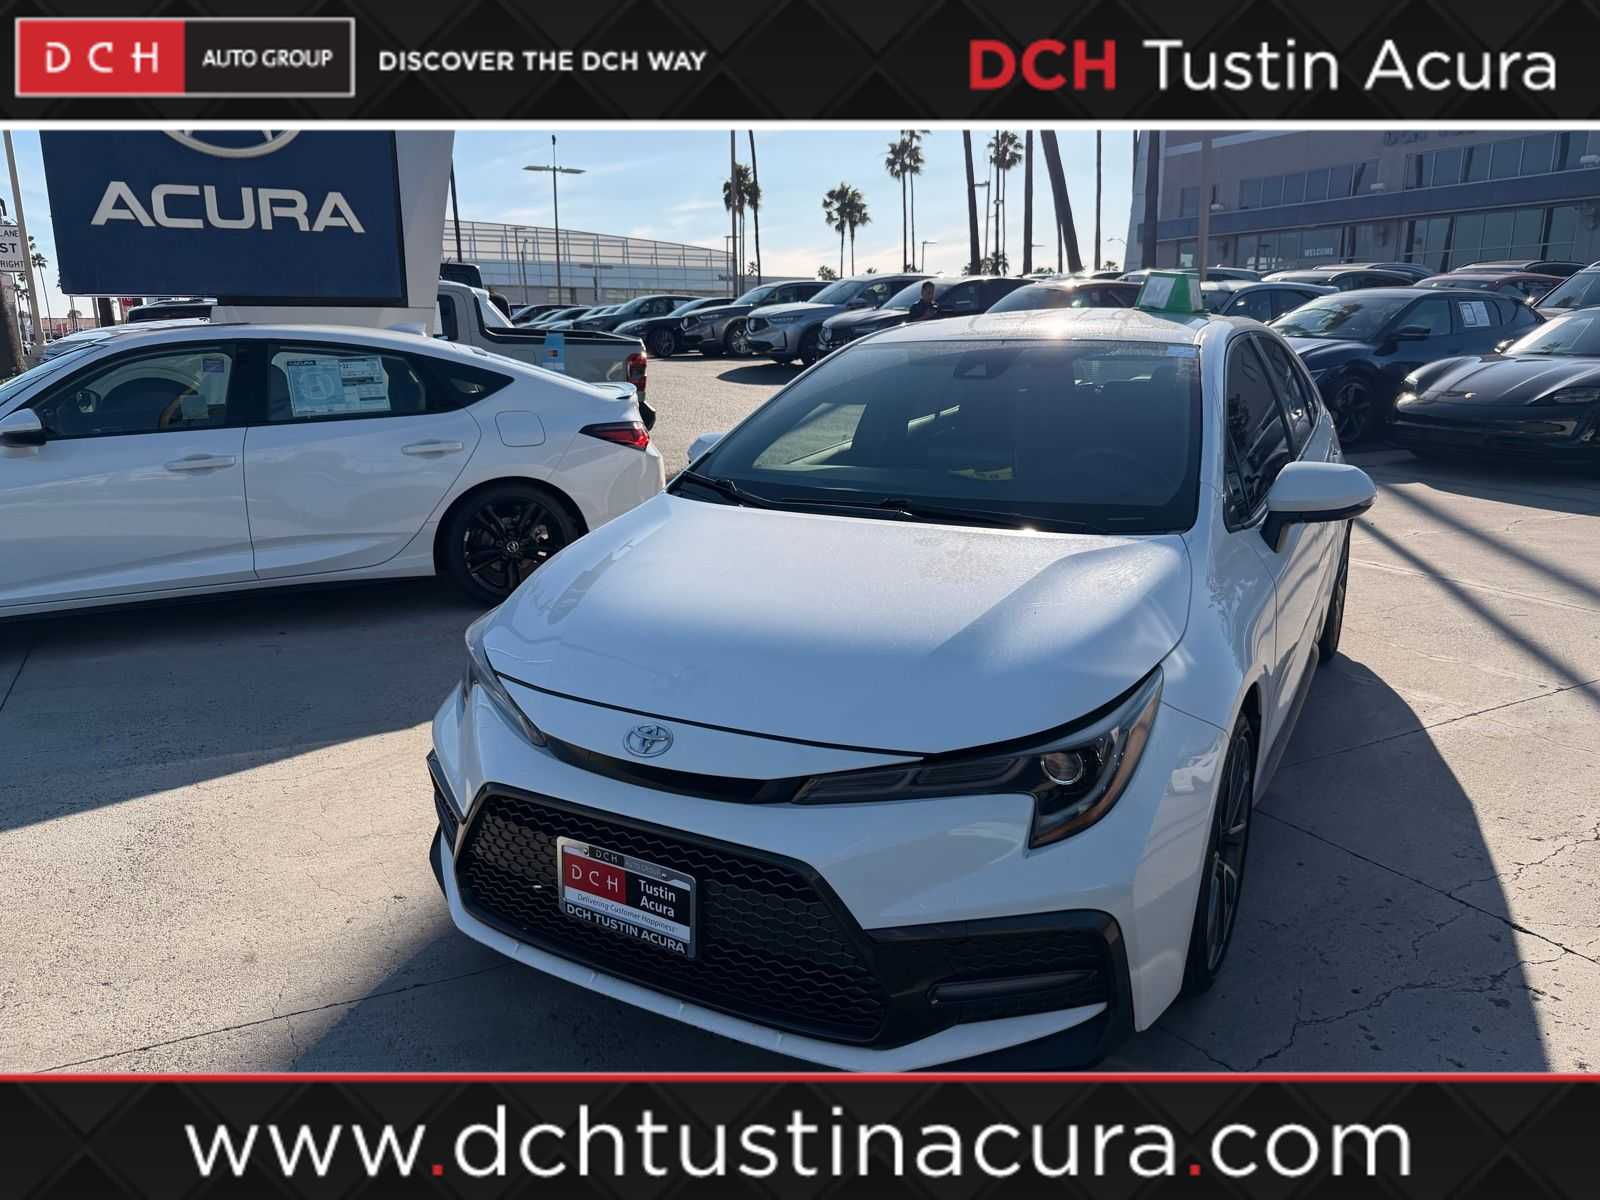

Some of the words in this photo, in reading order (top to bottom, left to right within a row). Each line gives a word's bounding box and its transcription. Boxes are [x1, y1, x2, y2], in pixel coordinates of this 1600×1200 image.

[91, 181, 365, 234] ACURA
[577, 893, 610, 911] Delivering
[638, 879, 676, 903] Tustin
[639, 895, 675, 918] Acura
[566, 903, 592, 921] DCH
[593, 912, 639, 938] TUSTIN
[640, 929, 686, 954] ACURA
